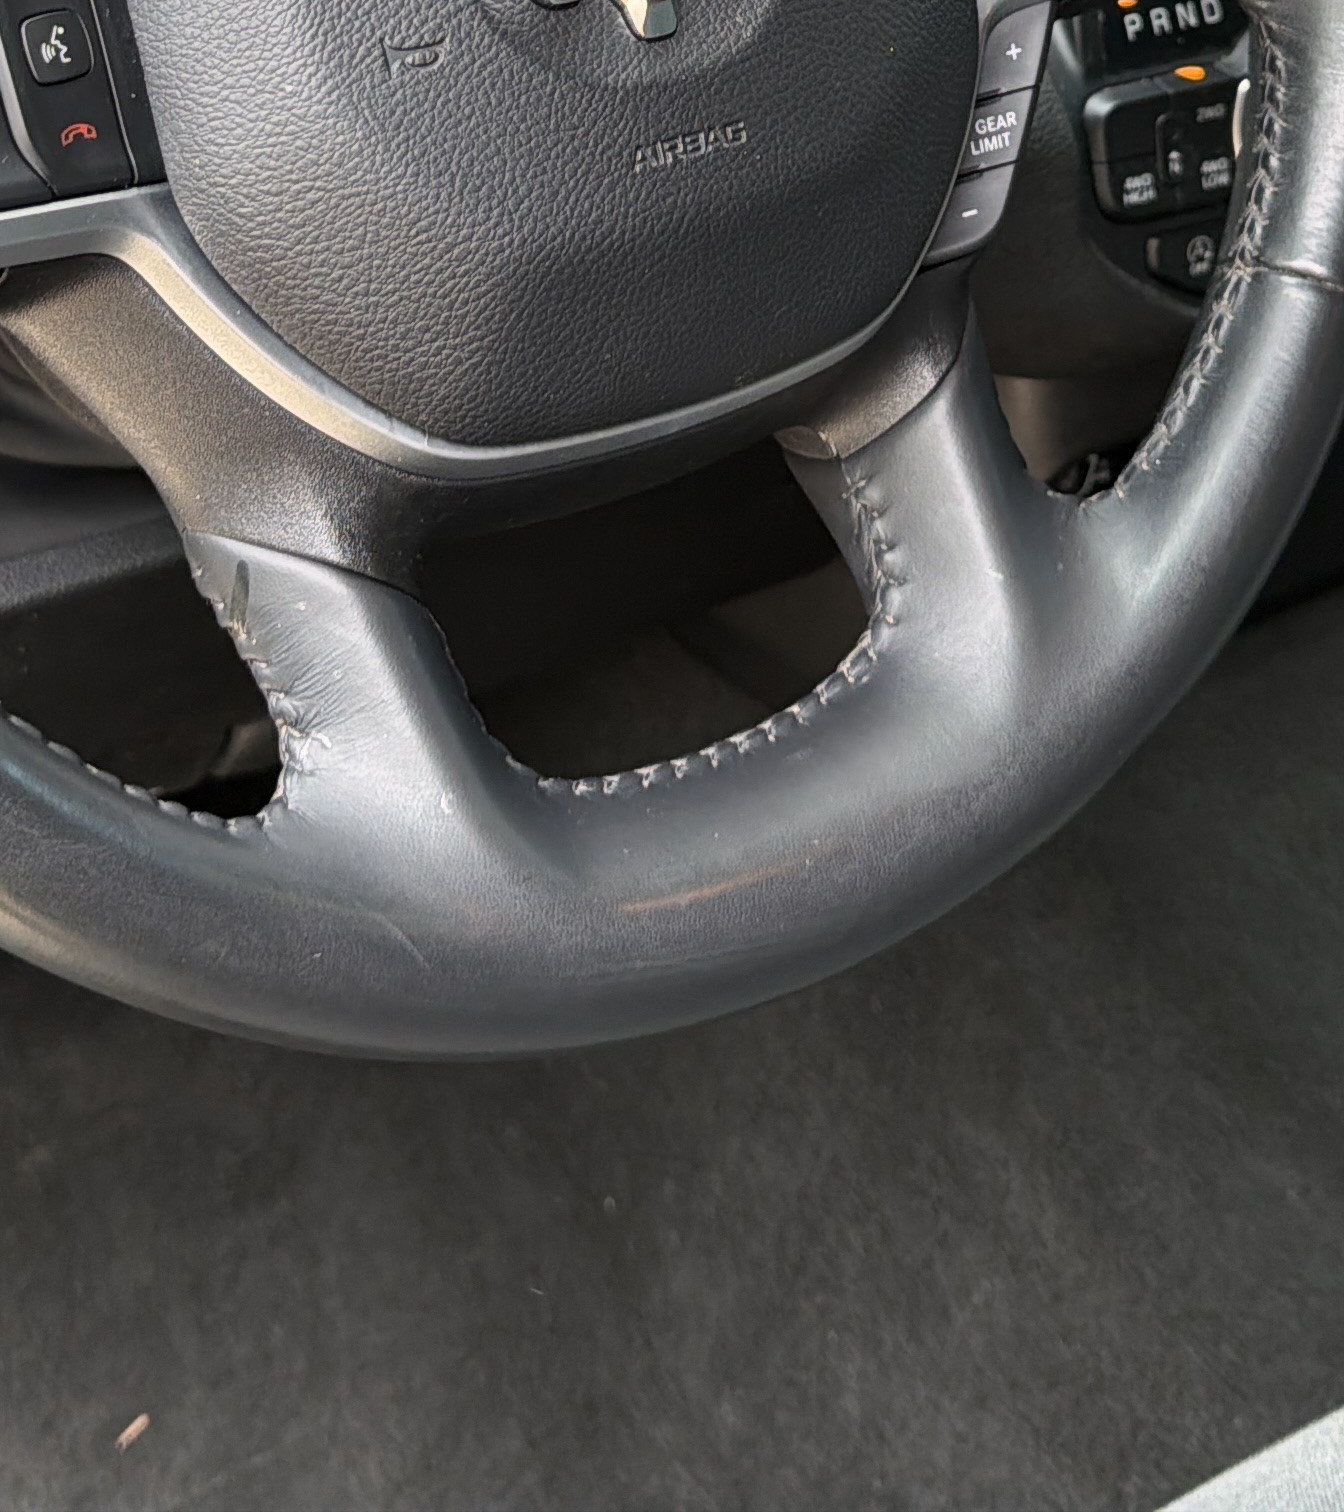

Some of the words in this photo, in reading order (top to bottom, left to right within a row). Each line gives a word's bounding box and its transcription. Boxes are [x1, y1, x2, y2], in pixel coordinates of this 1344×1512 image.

[975, 111, 1018, 135] GEAR
[635, 121, 747, 174] AIRBAG
[970, 133, 1012, 157] LIMIT
